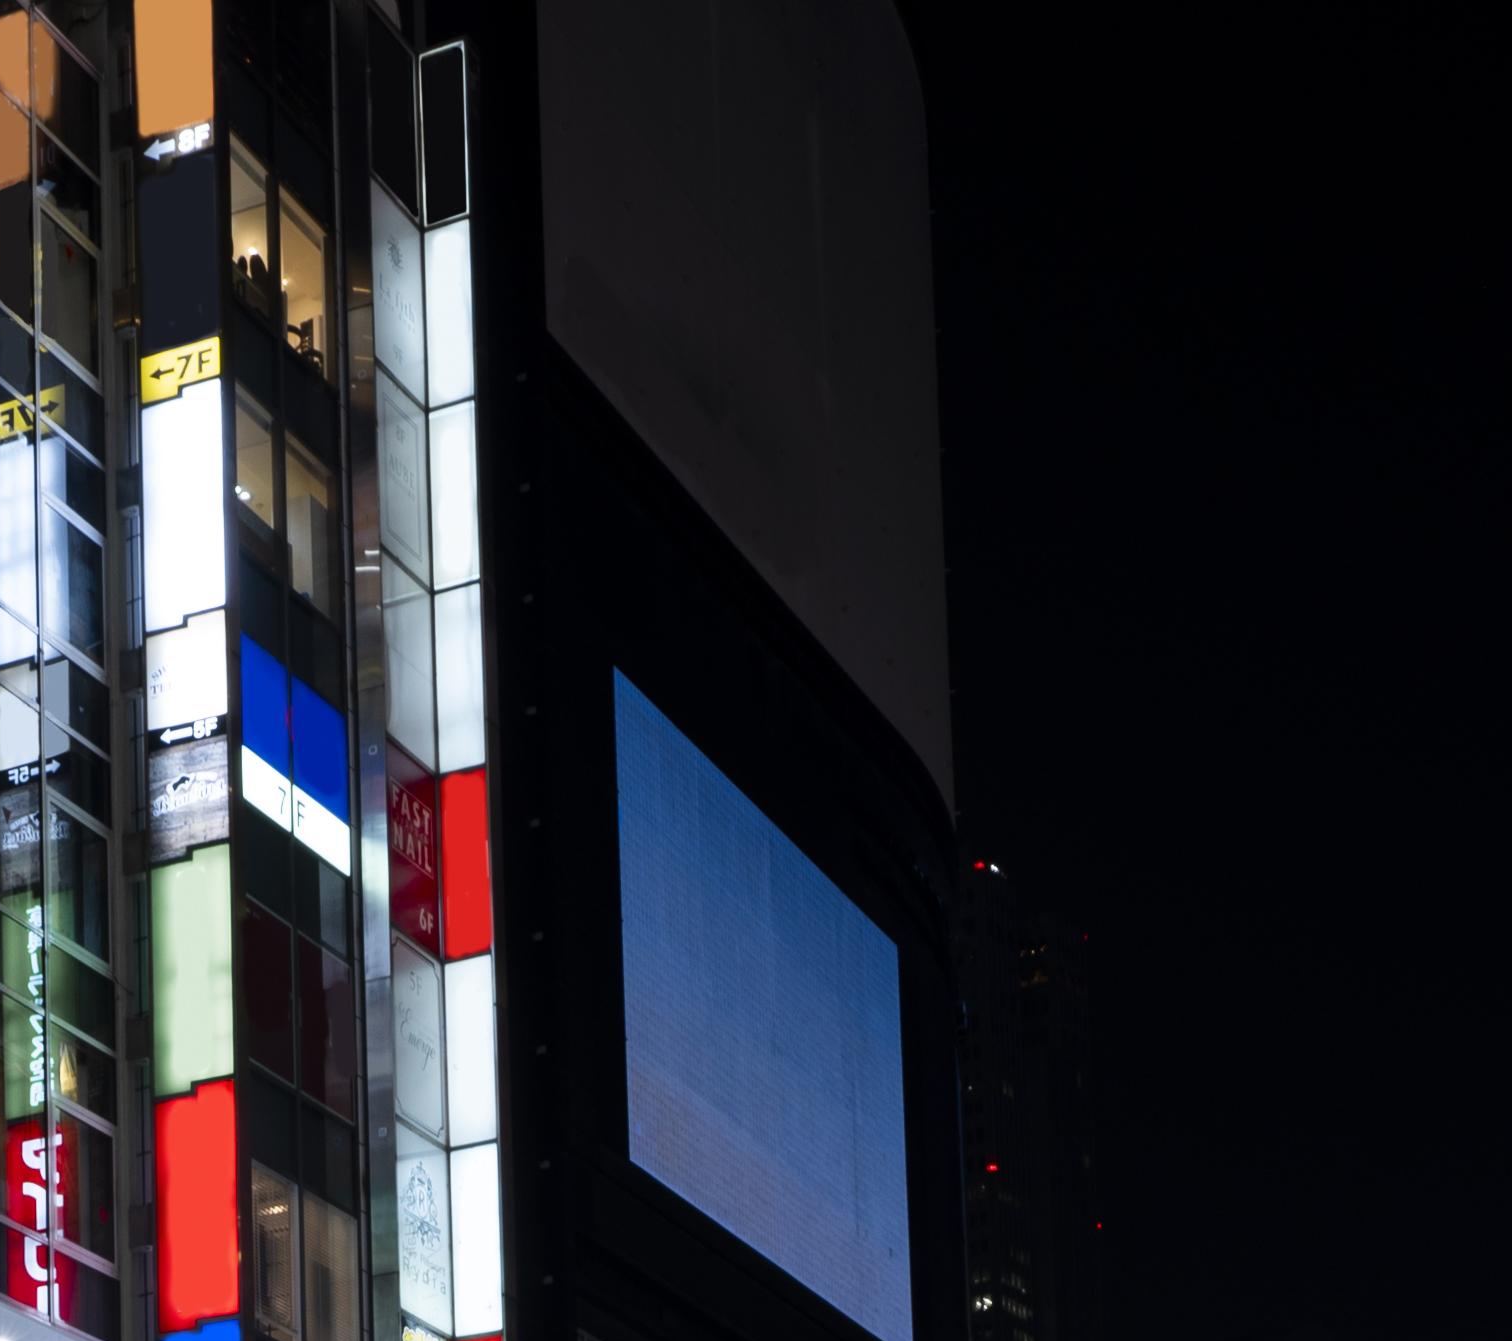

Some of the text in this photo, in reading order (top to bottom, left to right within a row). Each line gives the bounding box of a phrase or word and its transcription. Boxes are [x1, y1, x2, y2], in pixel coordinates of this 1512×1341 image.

[177, 122, 211, 155] 8F
[177, 347, 212, 381] 7F
[193, 716, 219, 740] 5F
[391, 782, 432, 836] FAST
[392, 827, 433, 876] NAIL
[419, 906, 435, 934] 6F
